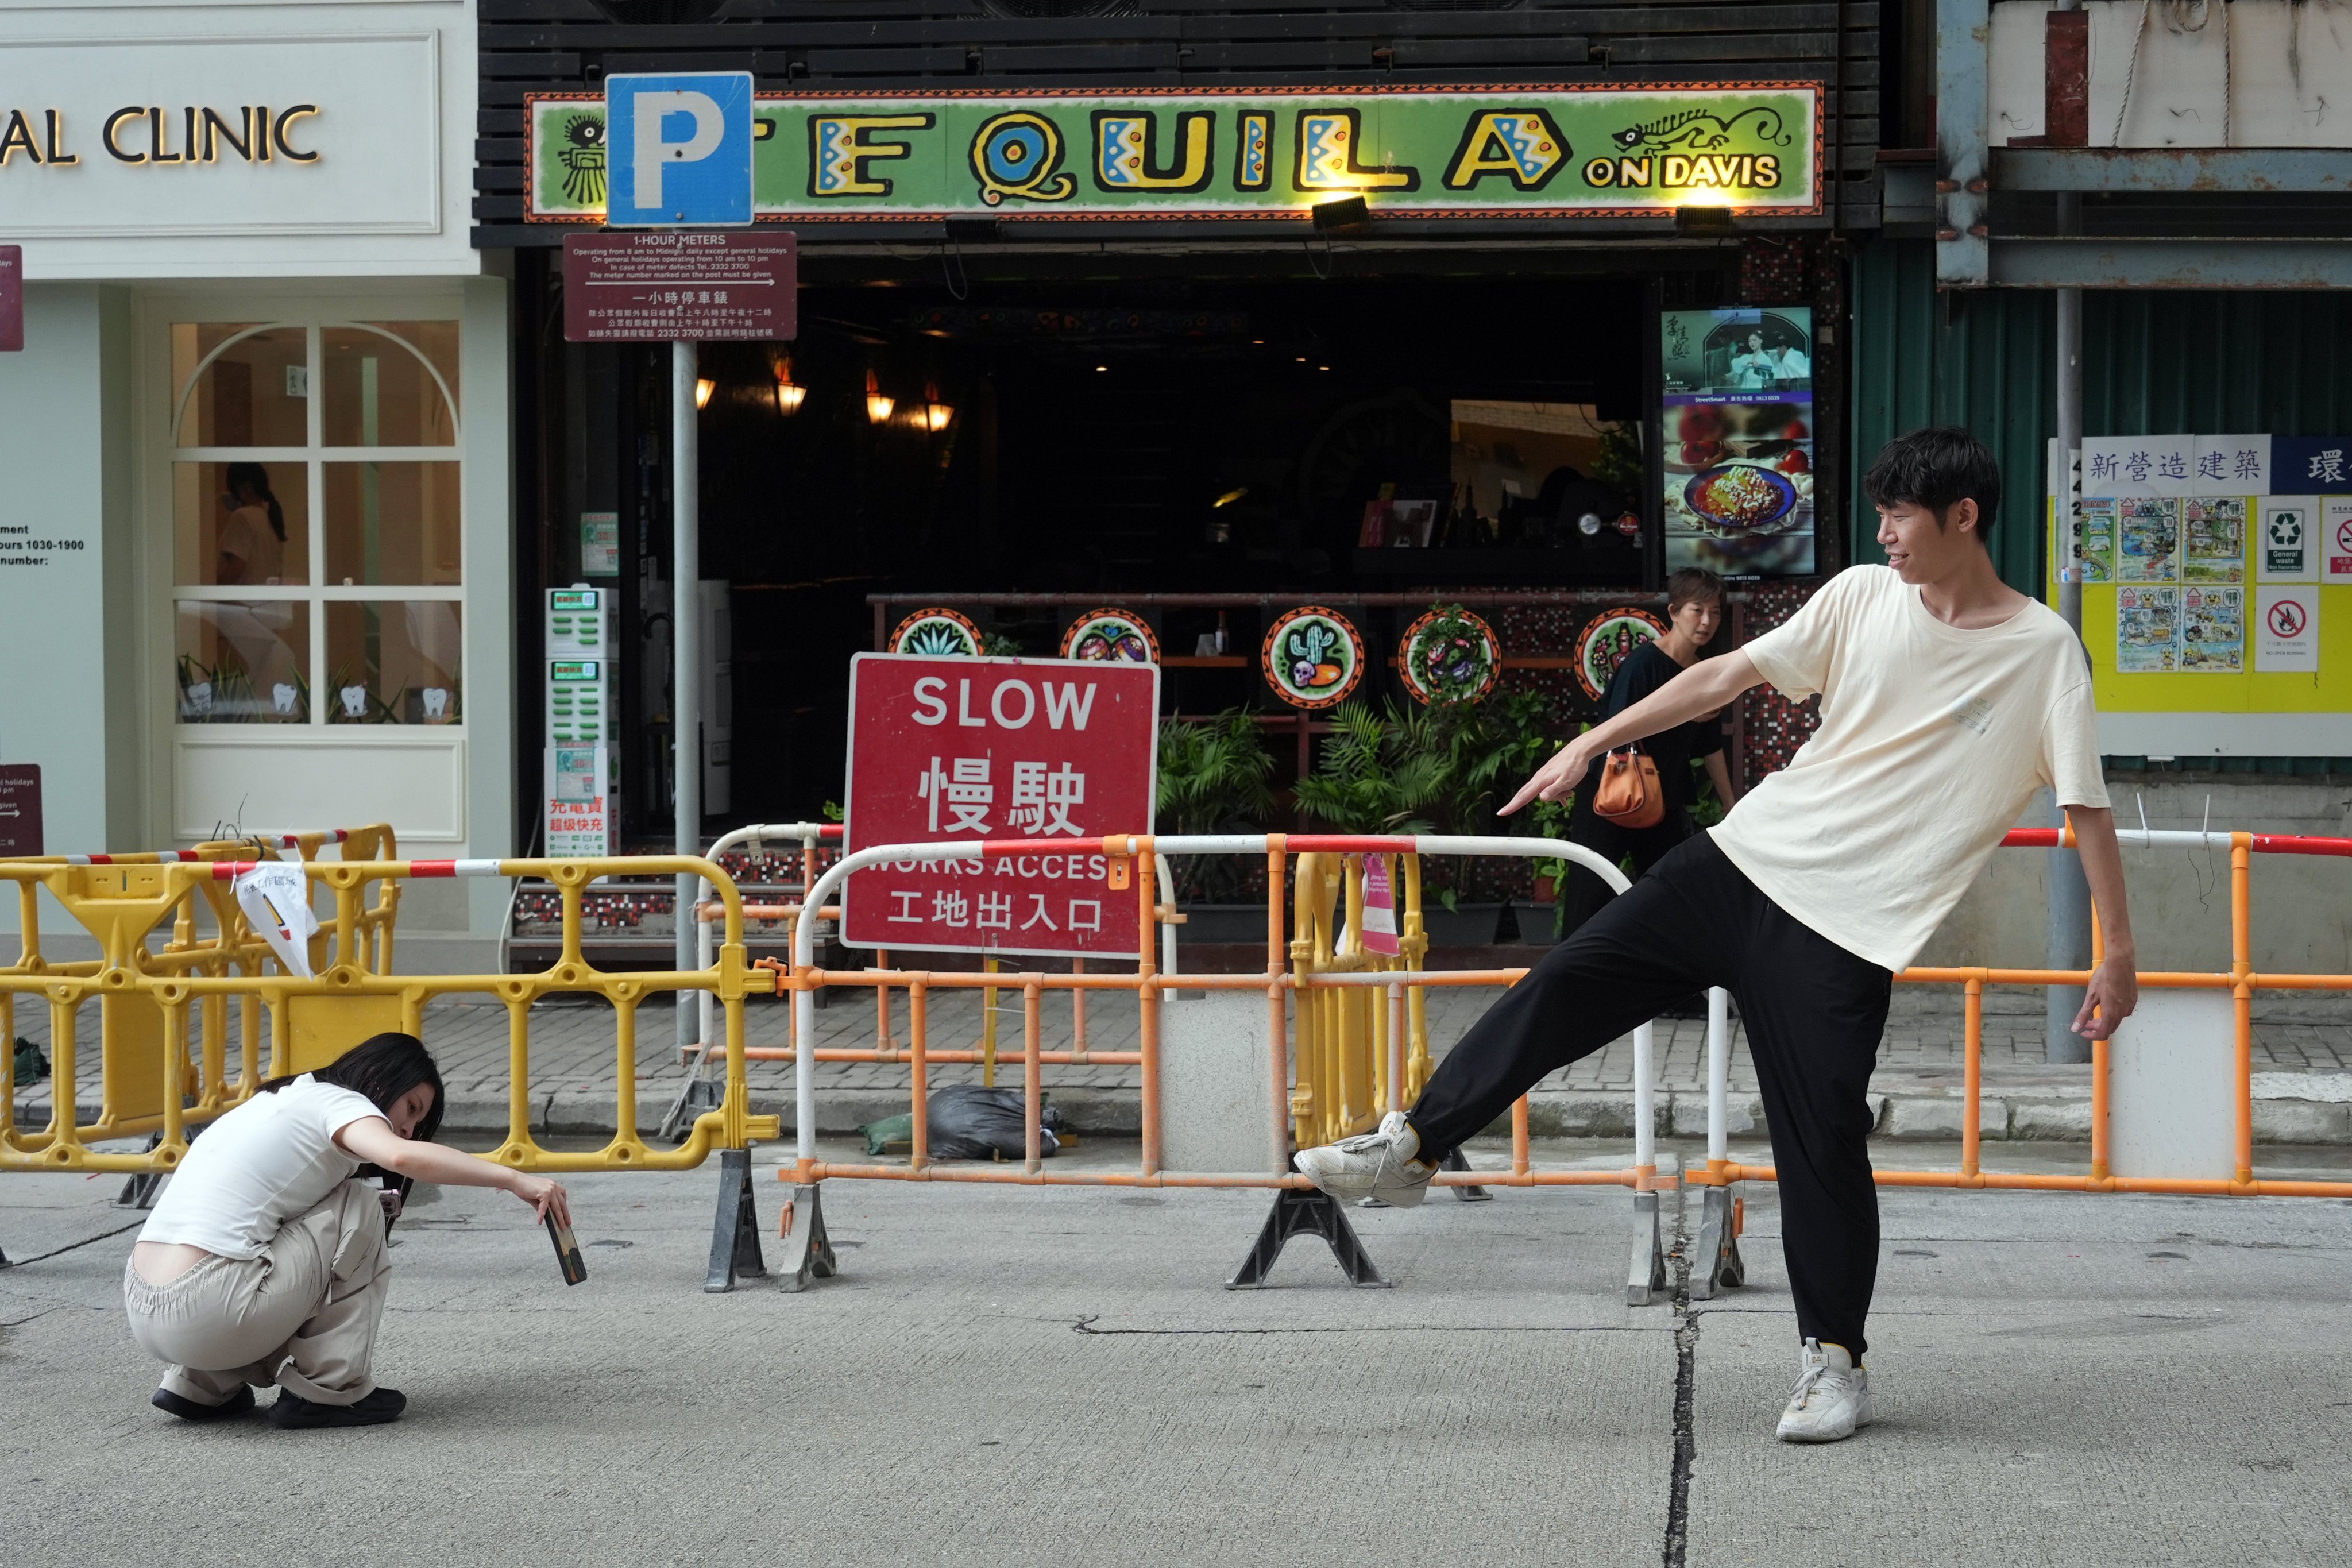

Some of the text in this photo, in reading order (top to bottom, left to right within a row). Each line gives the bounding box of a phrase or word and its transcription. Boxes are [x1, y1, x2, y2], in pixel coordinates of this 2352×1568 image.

[0, 105, 319, 164] AL CLINIC
[633, 91, 725, 209] P
[754, 108, 1575, 206] EQUILA
[1581, 153, 1782, 190] ON DAVIS
[573, 248, 607, 256] Operating
[656, 248, 684, 256] Midnight
[686, 248, 702, 256] daily
[731, 248, 756, 256] general
[758, 248, 787, 256] holidays
[634, 234, 726, 245] 1-HOUR METERS
[604, 256, 629, 264] general
[658, 329, 679, 338] 2332
[682, 329, 704, 338] 3700
[2089, 449, 2262, 482] 新營造建築
[2308, 449, 2352, 484] 環
[0, 525, 29, 534] ment
[26, 540, 84, 550] 1030-1900
[1, 555, 48, 565] number:
[910, 676, 1097, 731] SLOW
[5, 779, 34, 787] holidays
[918, 756, 1086, 837] 慢駛
[994, 854, 1107, 880] ACCES
[887, 889, 1102, 932] 工地出入口
